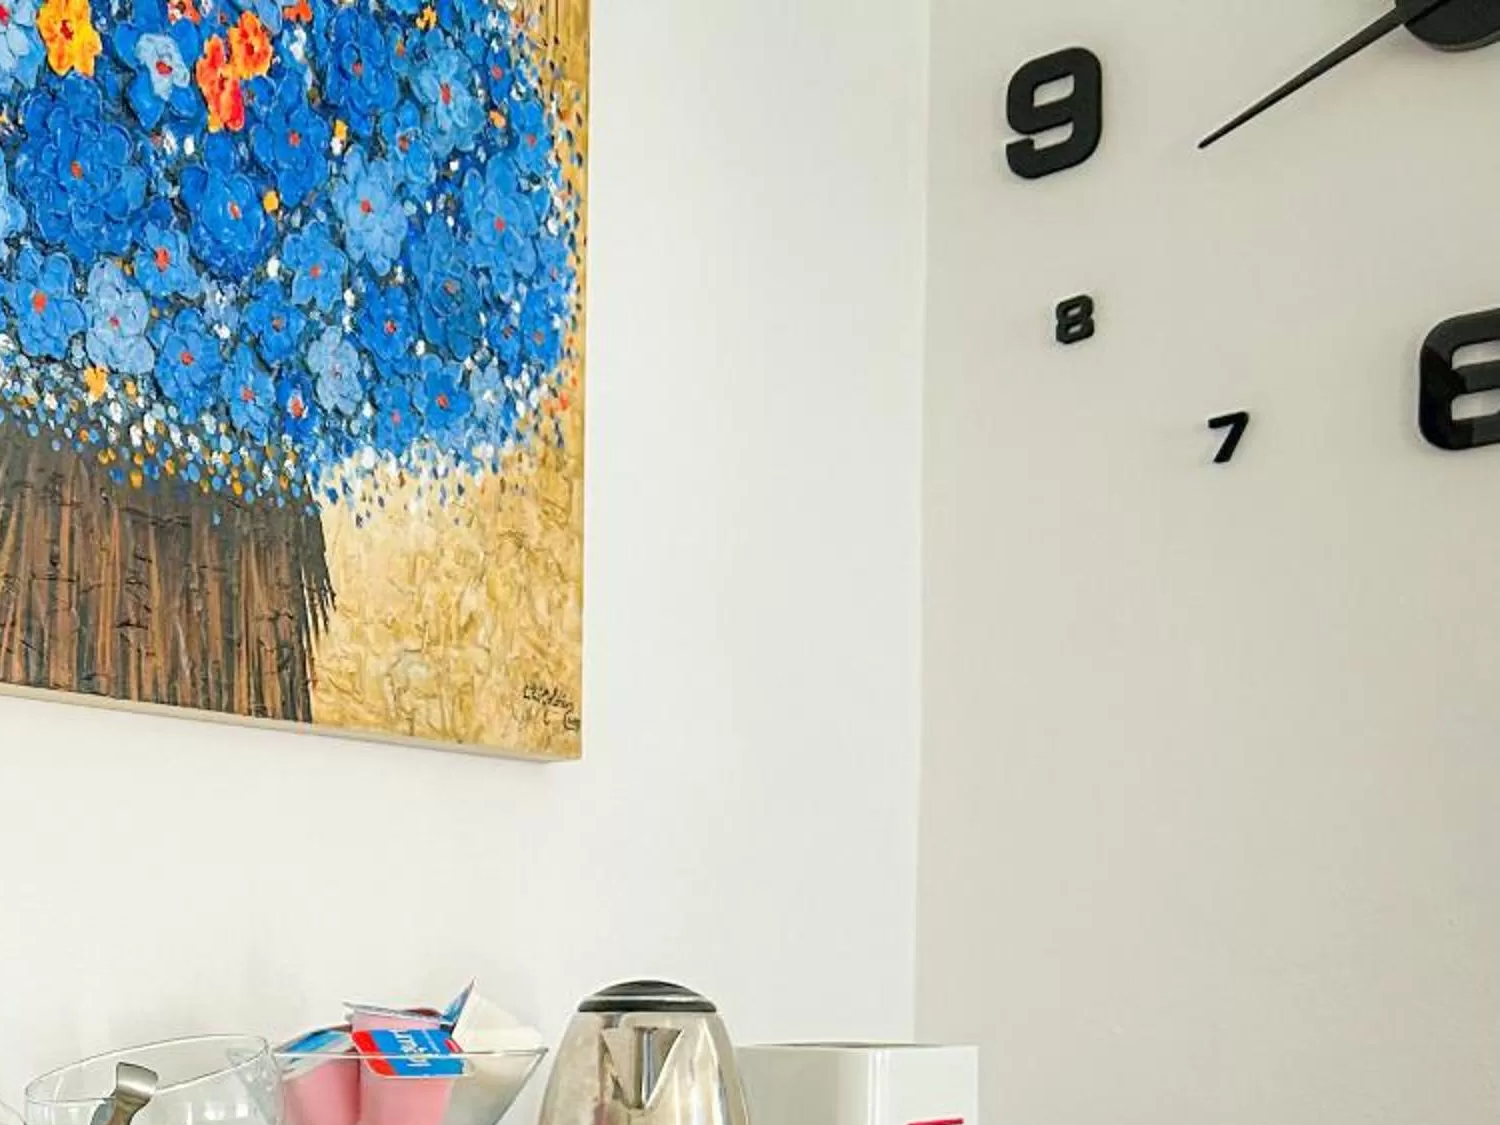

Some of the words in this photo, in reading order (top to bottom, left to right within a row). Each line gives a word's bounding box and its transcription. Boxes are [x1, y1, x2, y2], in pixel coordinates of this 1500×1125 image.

[1006, 46, 1103, 180] 9
[1055, 294, 1095, 345] 8
[1207, 410, 1250, 464] 7
